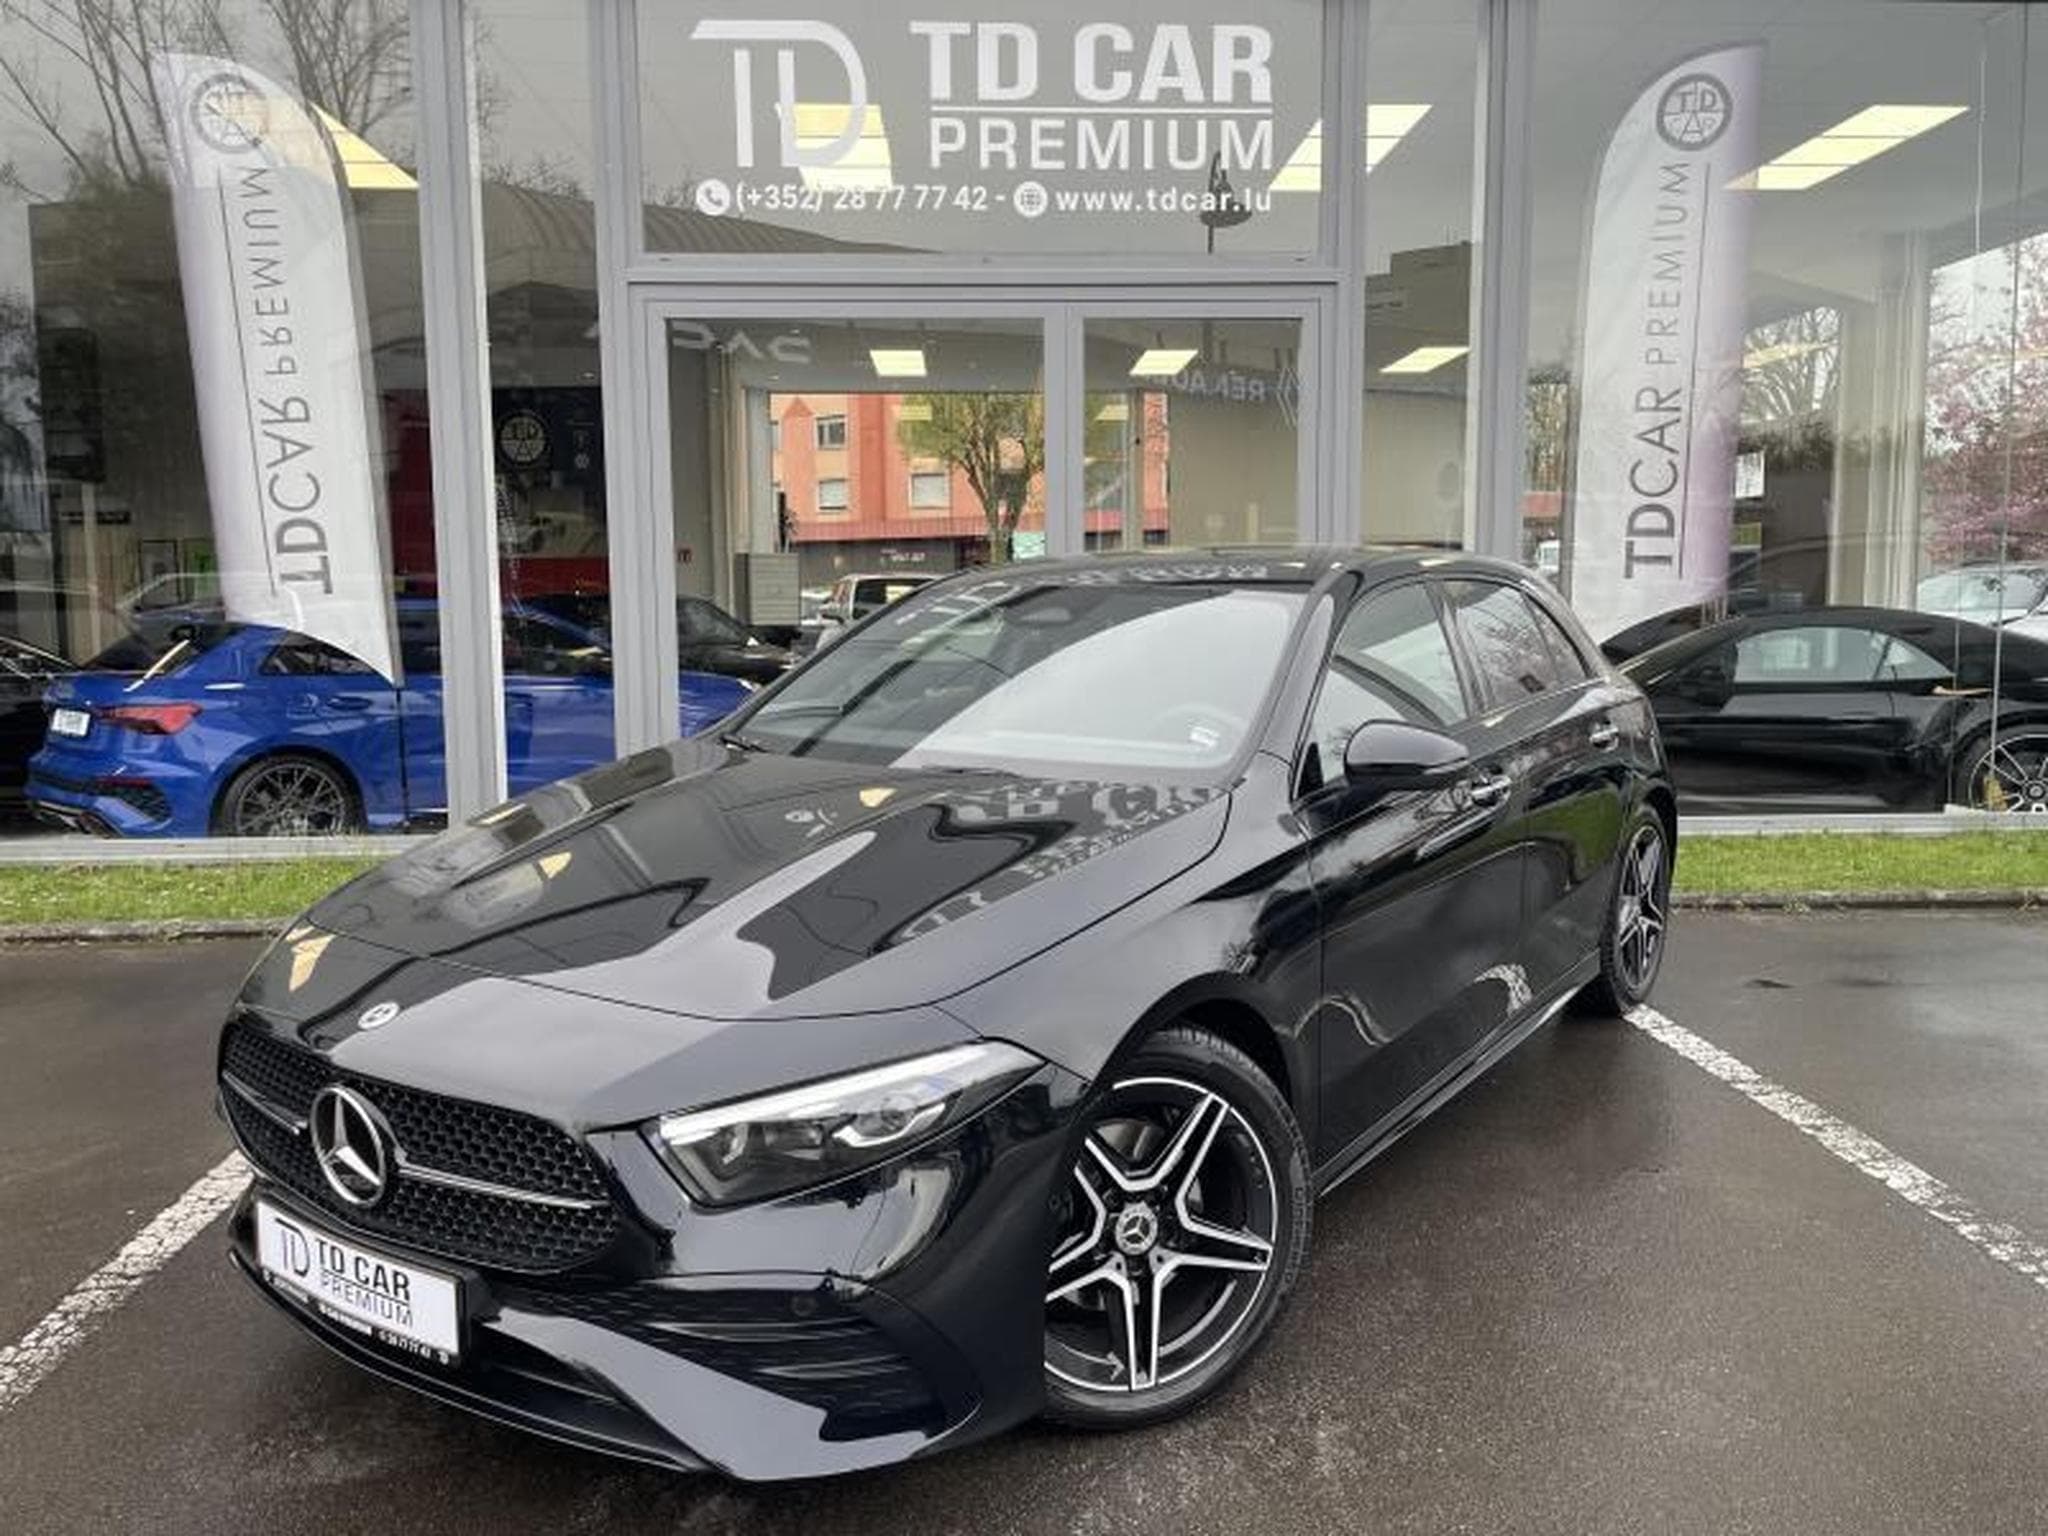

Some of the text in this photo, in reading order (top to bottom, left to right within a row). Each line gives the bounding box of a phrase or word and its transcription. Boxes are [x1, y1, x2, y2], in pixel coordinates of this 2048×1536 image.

[909, 22, 1273, 103] TD CAR
[930, 119, 1274, 171] PREMIUM
[736, 180, 823, 213] (+352)
[833, 184, 866, 210] 28
[872, 184, 906, 210] 77
[914, 185, 948, 210] 77
[953, 186, 988, 211] 42
[1055, 187, 1272, 212] www.tdcar.lu
[1624, 162, 1690, 580] TDCAR PREMIUM
[315, 1238, 345, 1275] TD
[353, 1255, 411, 1302] CAR
[320, 1271, 415, 1329] PREMIUM
